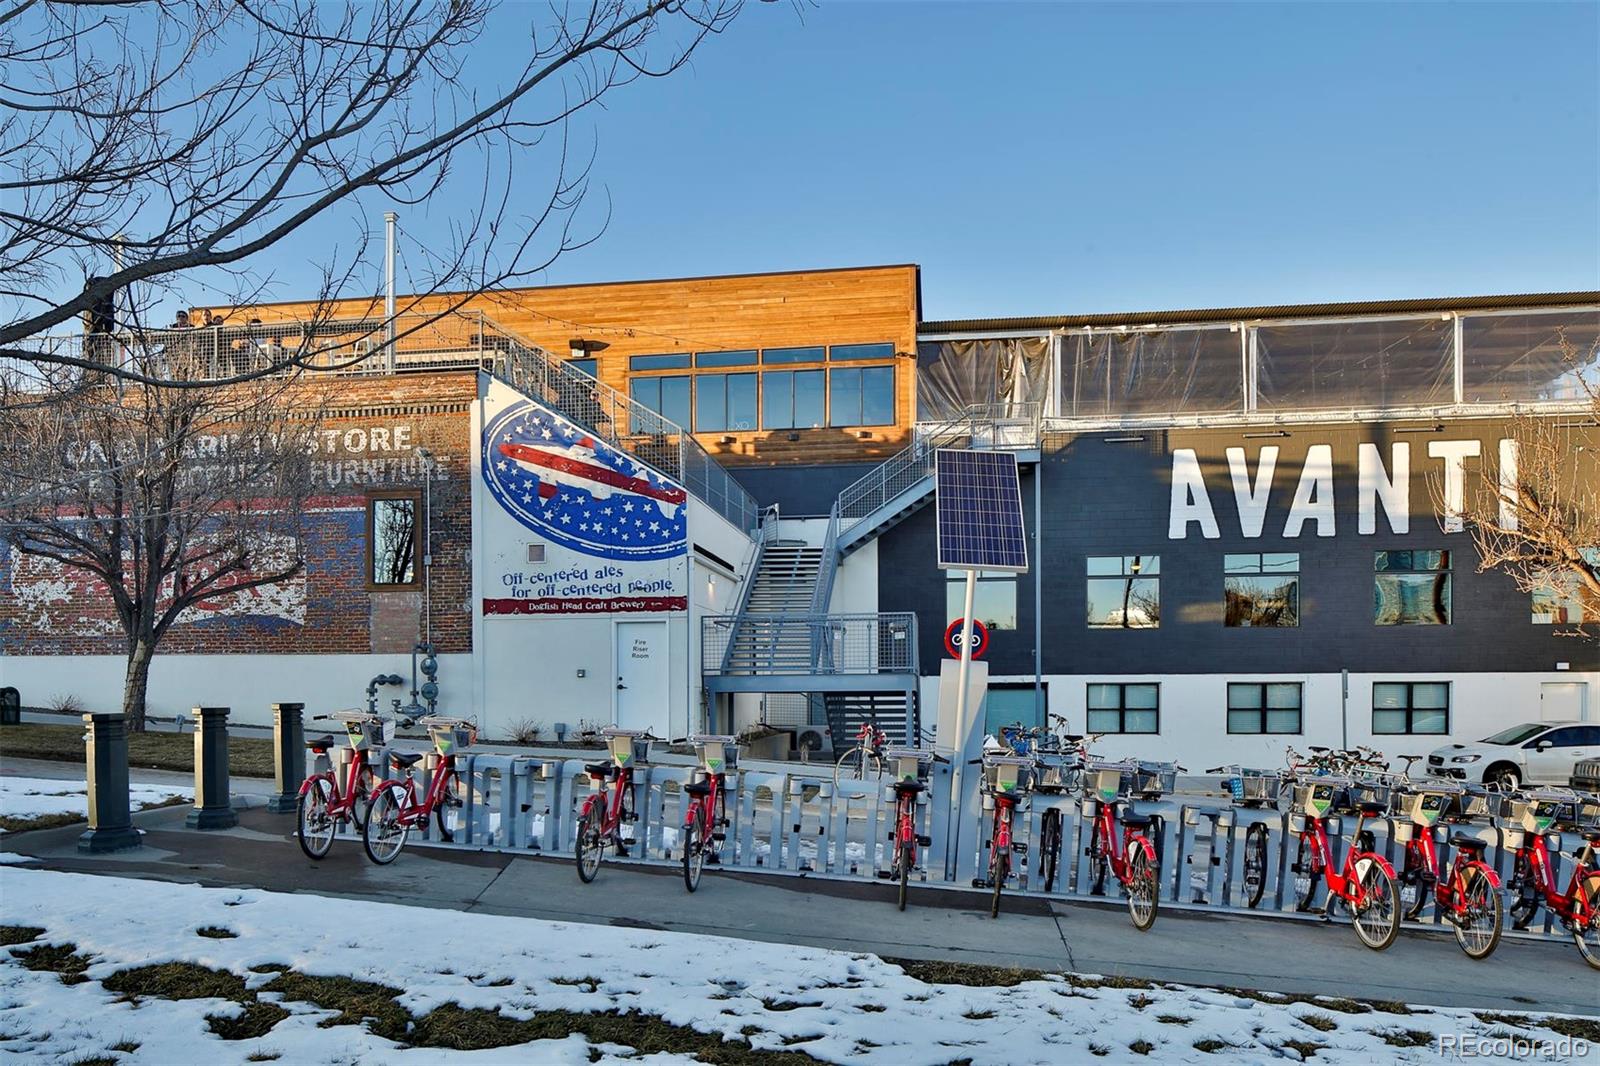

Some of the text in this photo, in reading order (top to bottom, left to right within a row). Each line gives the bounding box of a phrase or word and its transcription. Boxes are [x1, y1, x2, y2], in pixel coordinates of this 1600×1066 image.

[301, 425, 412, 454] STORE
[310, 455, 451, 486] FURNITURE
[1167, 439, 1520, 540] AVANTI
[594, 565, 624, 579] ales
[511, 585, 531, 598] for
[537, 582, 621, 597] off-centered
[528, 600, 647, 611] Dogfish Head Craft Brewery
